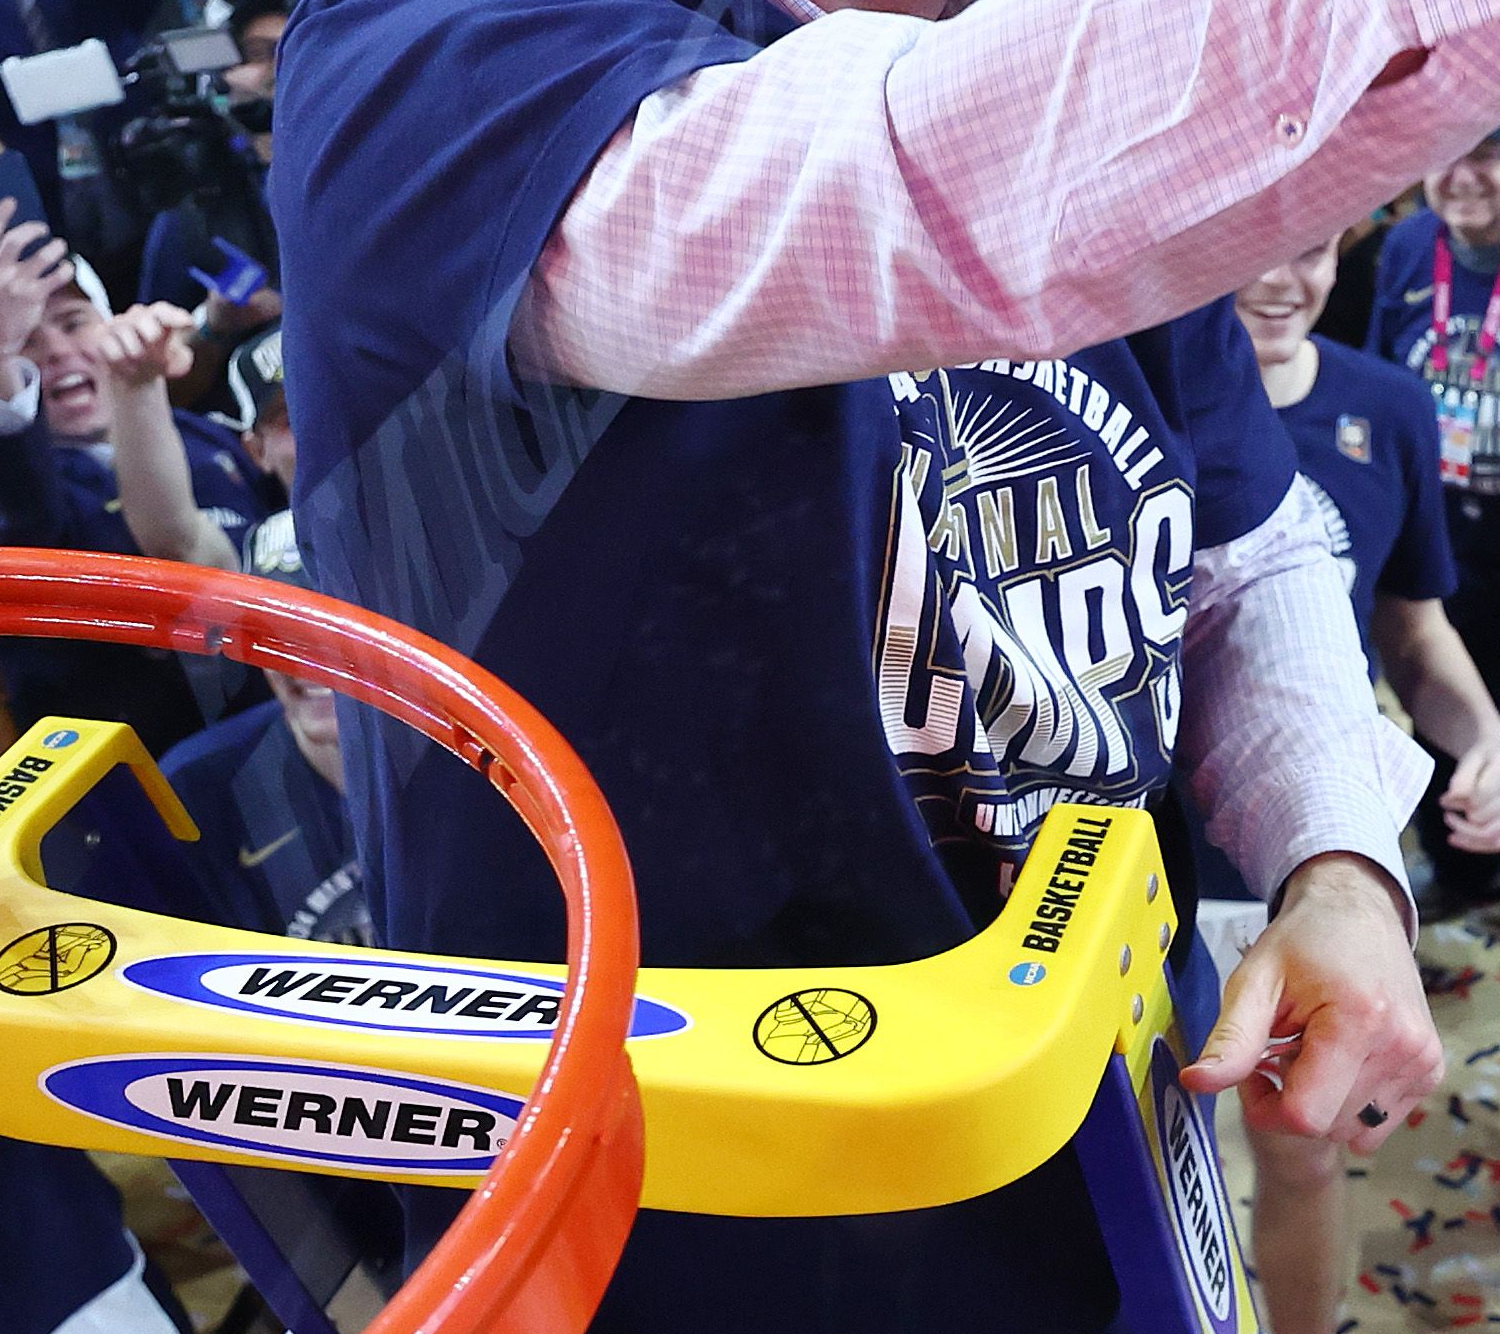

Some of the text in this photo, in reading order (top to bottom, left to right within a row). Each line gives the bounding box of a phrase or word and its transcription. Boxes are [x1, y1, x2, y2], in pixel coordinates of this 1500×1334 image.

[1021, 816, 1114, 955] BASKETBALL
[237, 966, 566, 1026] WERNER
[166, 1077, 498, 1153] WERNER
[1165, 1111, 1229, 1308] WERNER
